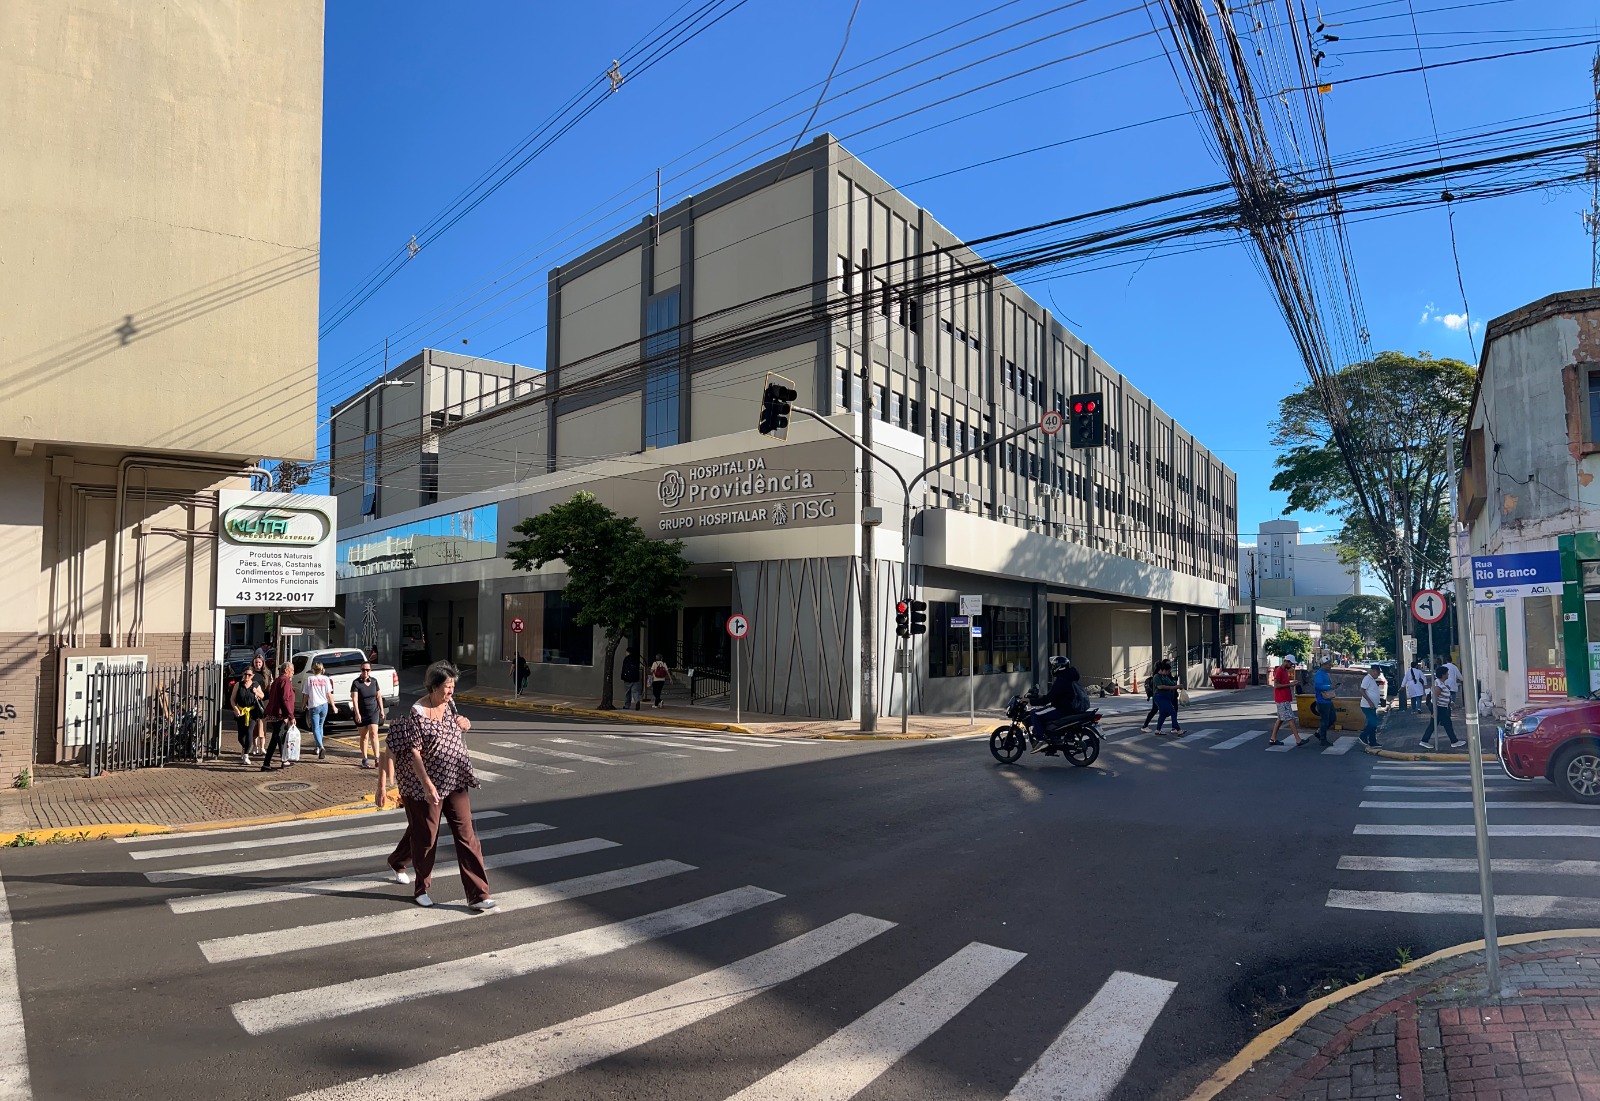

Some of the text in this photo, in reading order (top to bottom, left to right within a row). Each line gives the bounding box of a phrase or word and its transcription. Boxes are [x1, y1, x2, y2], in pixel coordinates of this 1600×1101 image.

[1045, 416, 1058, 426] 40
[689, 456, 766, 481] HOSPITAL DA
[689, 468, 815, 503] Providência
[659, 508, 768, 530] GRUPO HOSPITALAR
[261, 560, 284, 568] Ervas,
[1476, 567, 1537, 580] Rio Branco
[236, 592, 314, 602] 43 3122-0017
[1546, 677, 1567, 692] PBM
